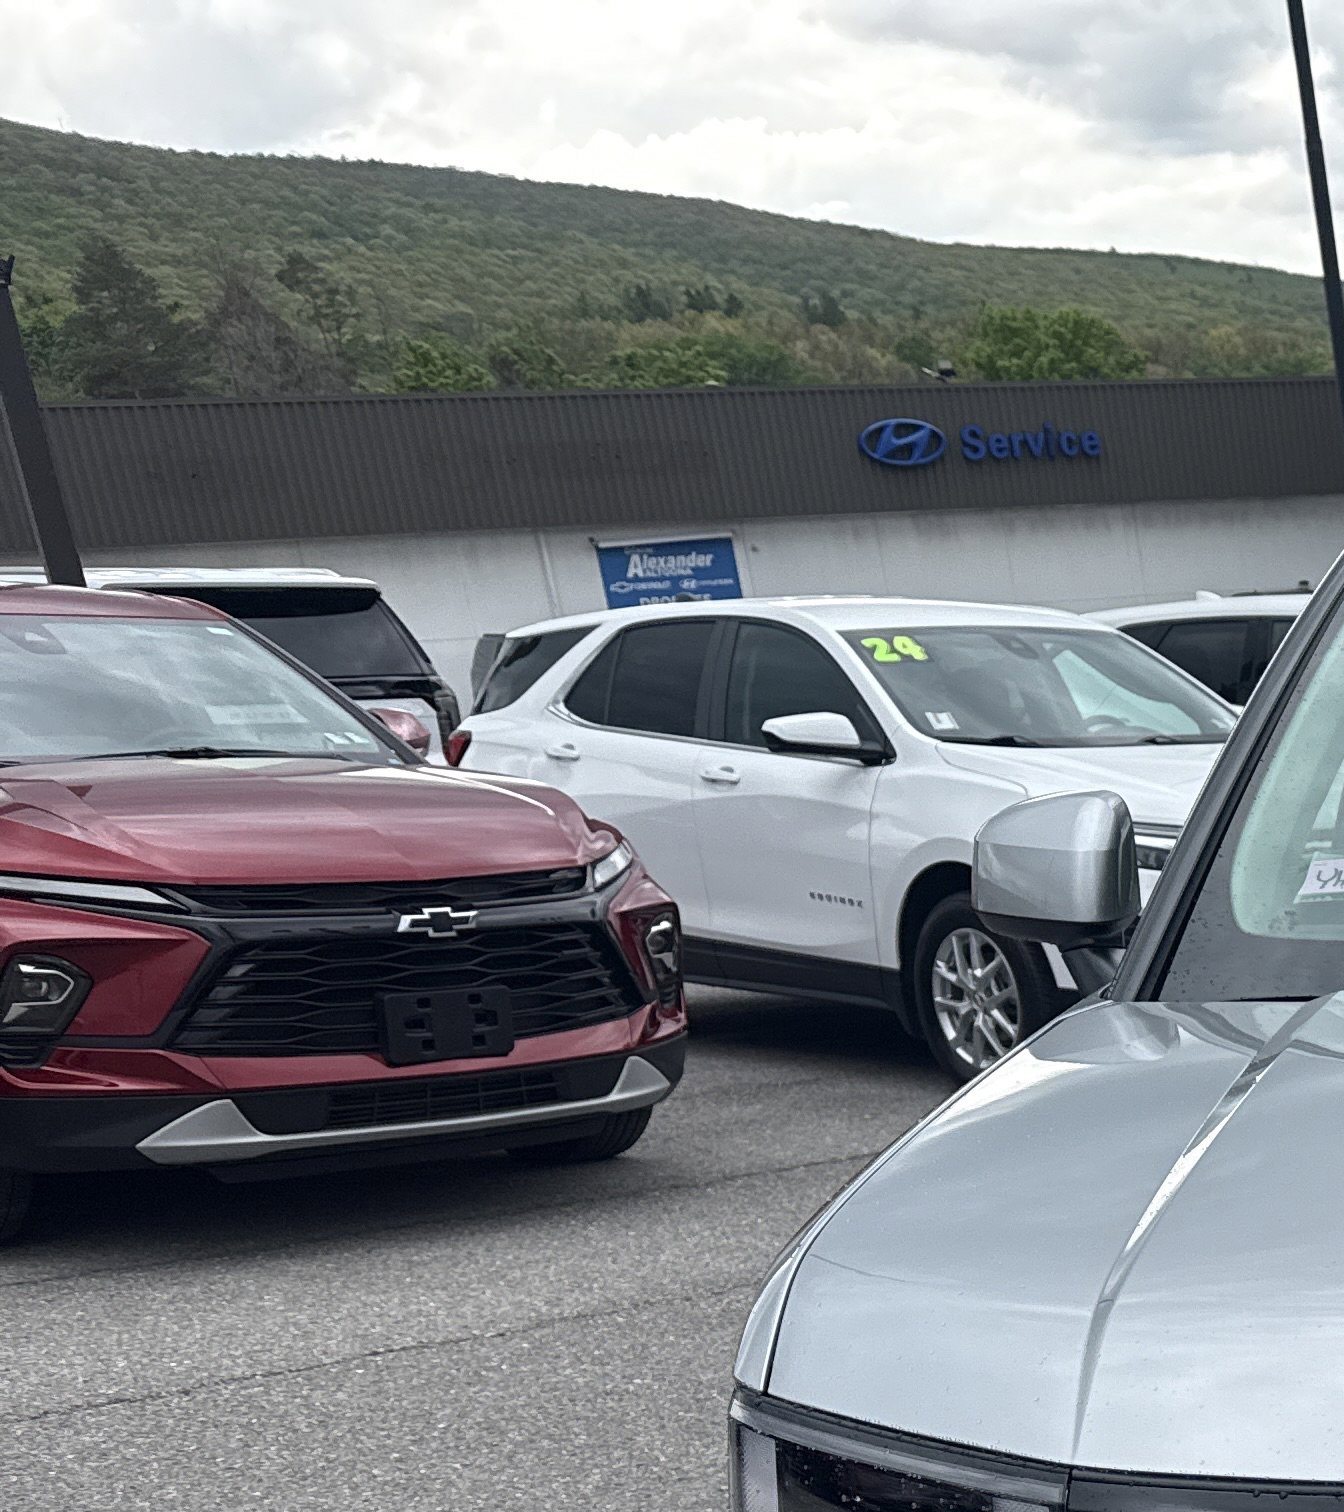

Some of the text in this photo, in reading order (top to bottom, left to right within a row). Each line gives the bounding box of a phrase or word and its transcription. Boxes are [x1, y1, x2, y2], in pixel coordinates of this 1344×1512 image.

[960, 420, 1102, 460] Service
[626, 551, 714, 578] Alexander
[860, 635, 928, 662] 24
